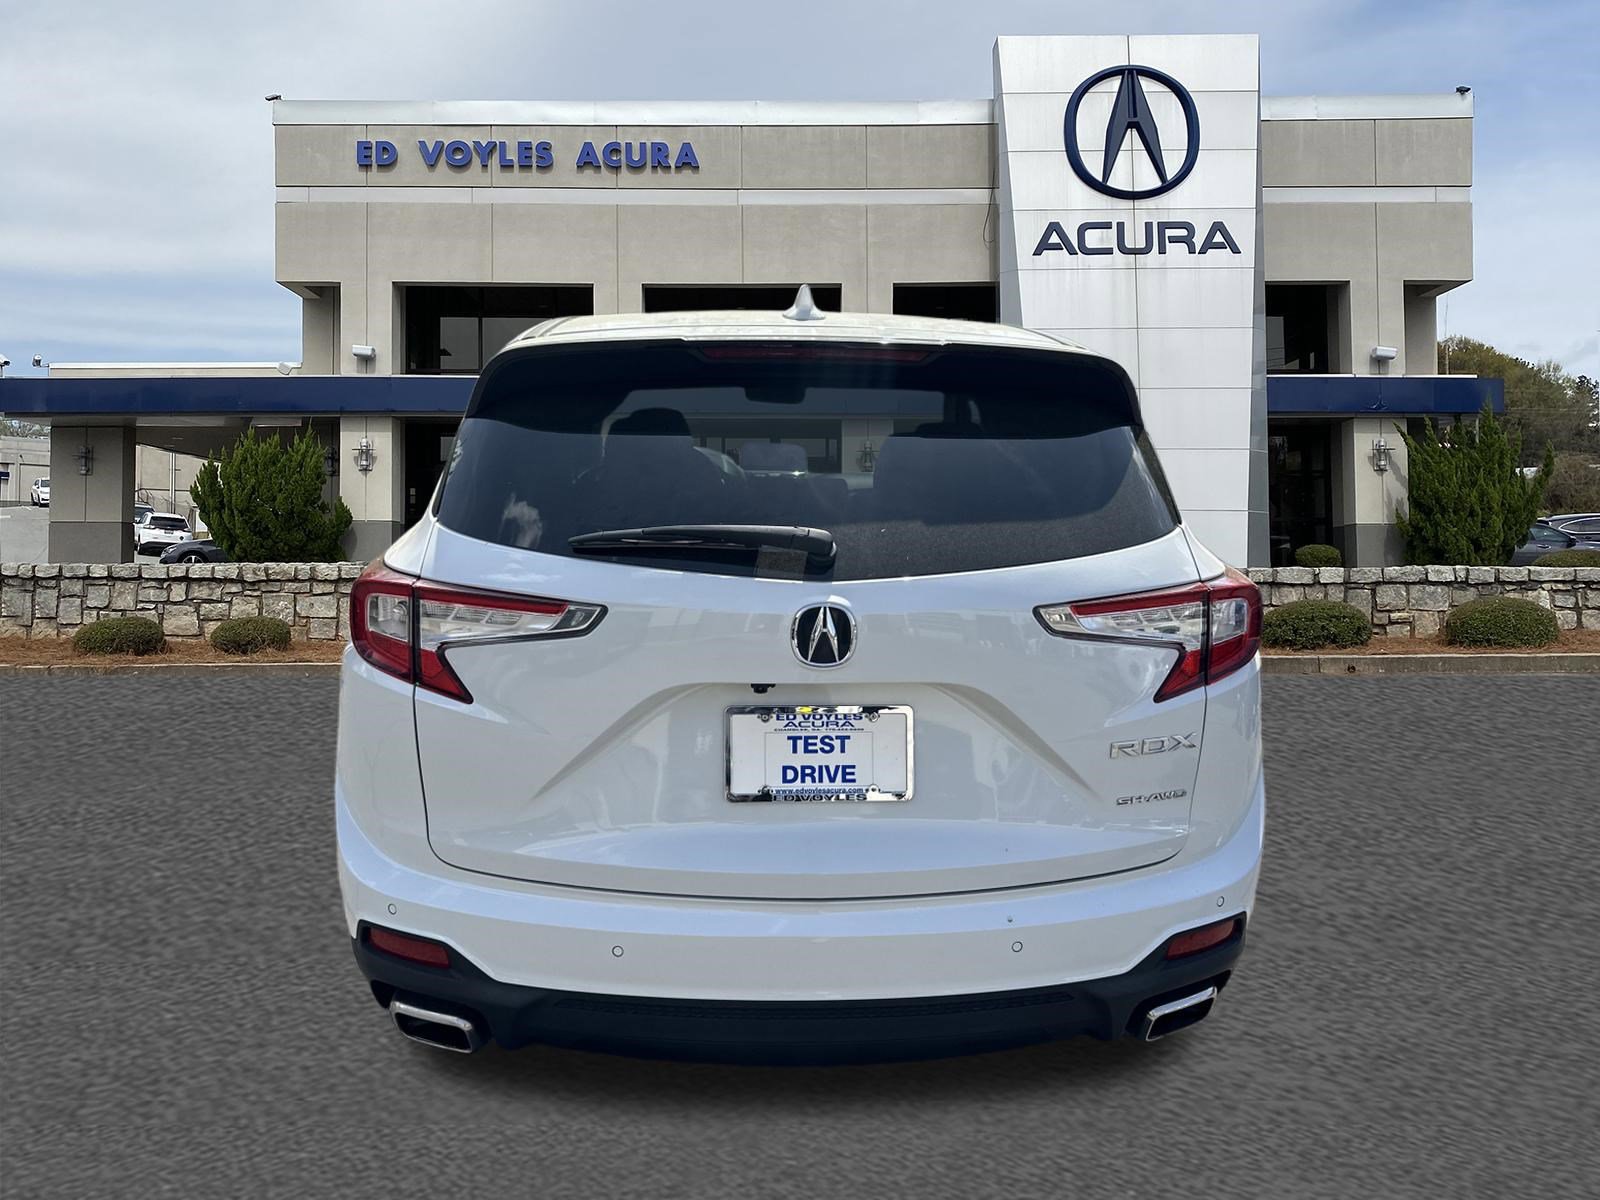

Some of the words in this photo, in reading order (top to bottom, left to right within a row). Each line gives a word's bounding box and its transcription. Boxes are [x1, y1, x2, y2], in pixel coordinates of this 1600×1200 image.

[357, 140, 397, 167] ED
[418, 140, 553, 167] VOYLES
[576, 141, 700, 167] ACURA
[1032, 221, 1241, 256] ACURA
[787, 735, 850, 754] TEST
[1110, 732, 1196, 759] RDX
[782, 765, 856, 784] DRIVE
[775, 787, 863, 795] www.edvoylesacura.com
